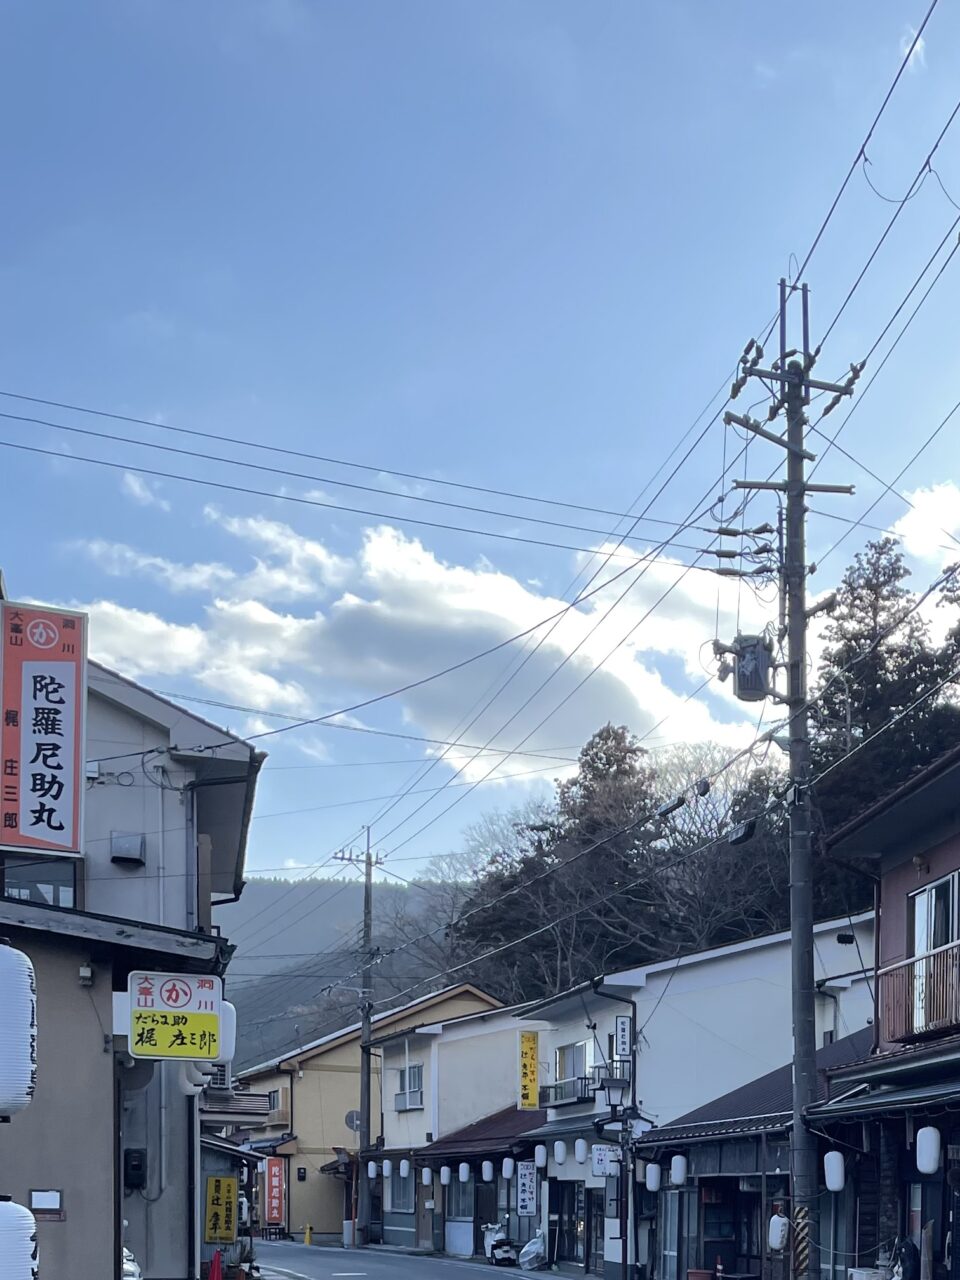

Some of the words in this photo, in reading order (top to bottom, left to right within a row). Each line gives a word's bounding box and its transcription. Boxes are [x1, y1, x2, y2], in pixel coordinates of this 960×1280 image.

[29, 674, 66, 831] 陀羅尼助丸
[196, 978, 214, 1011] 洞川
